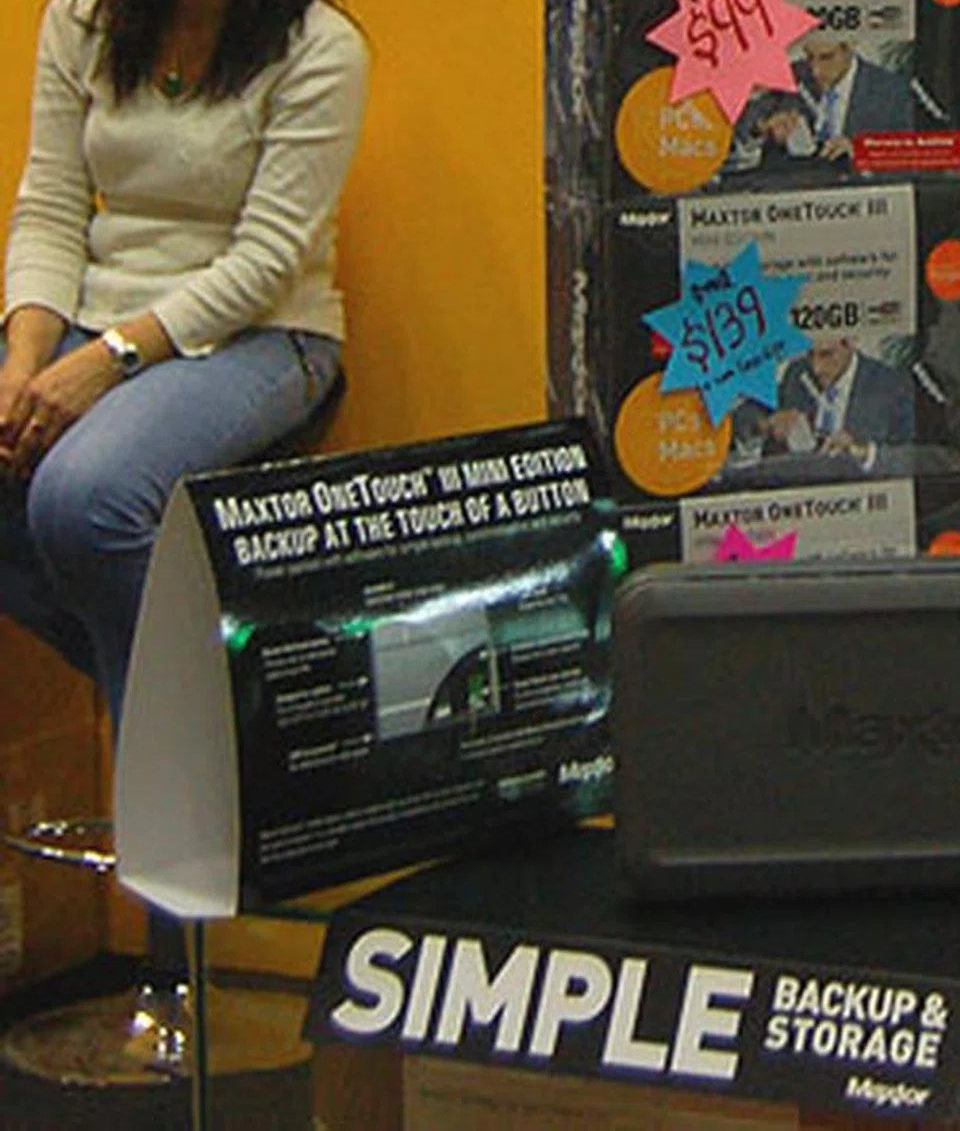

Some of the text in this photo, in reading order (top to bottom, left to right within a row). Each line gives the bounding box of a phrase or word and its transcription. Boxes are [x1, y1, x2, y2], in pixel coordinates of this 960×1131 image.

[691, 208, 761, 227] MAXTOR
[682, 285, 767, 373] $139
[214, 489, 313, 531] MAXTOR
[510, 444, 588, 481] EDITION
[233, 524, 320, 566] BACKUP
[323, 519, 351, 550] AT
[354, 511, 396, 544] THE
[396, 500, 465, 536] TOUCH
[464, 492, 492, 526] OF
[494, 491, 513, 519] A
[511, 477, 590, 516] BUTTON
[331, 927, 755, 1081] SIMPLE
[772, 975, 950, 1031] BACKUP &
[764, 1016, 943, 1070] STORAGE
[846, 1076, 930, 1108] Maxtor
